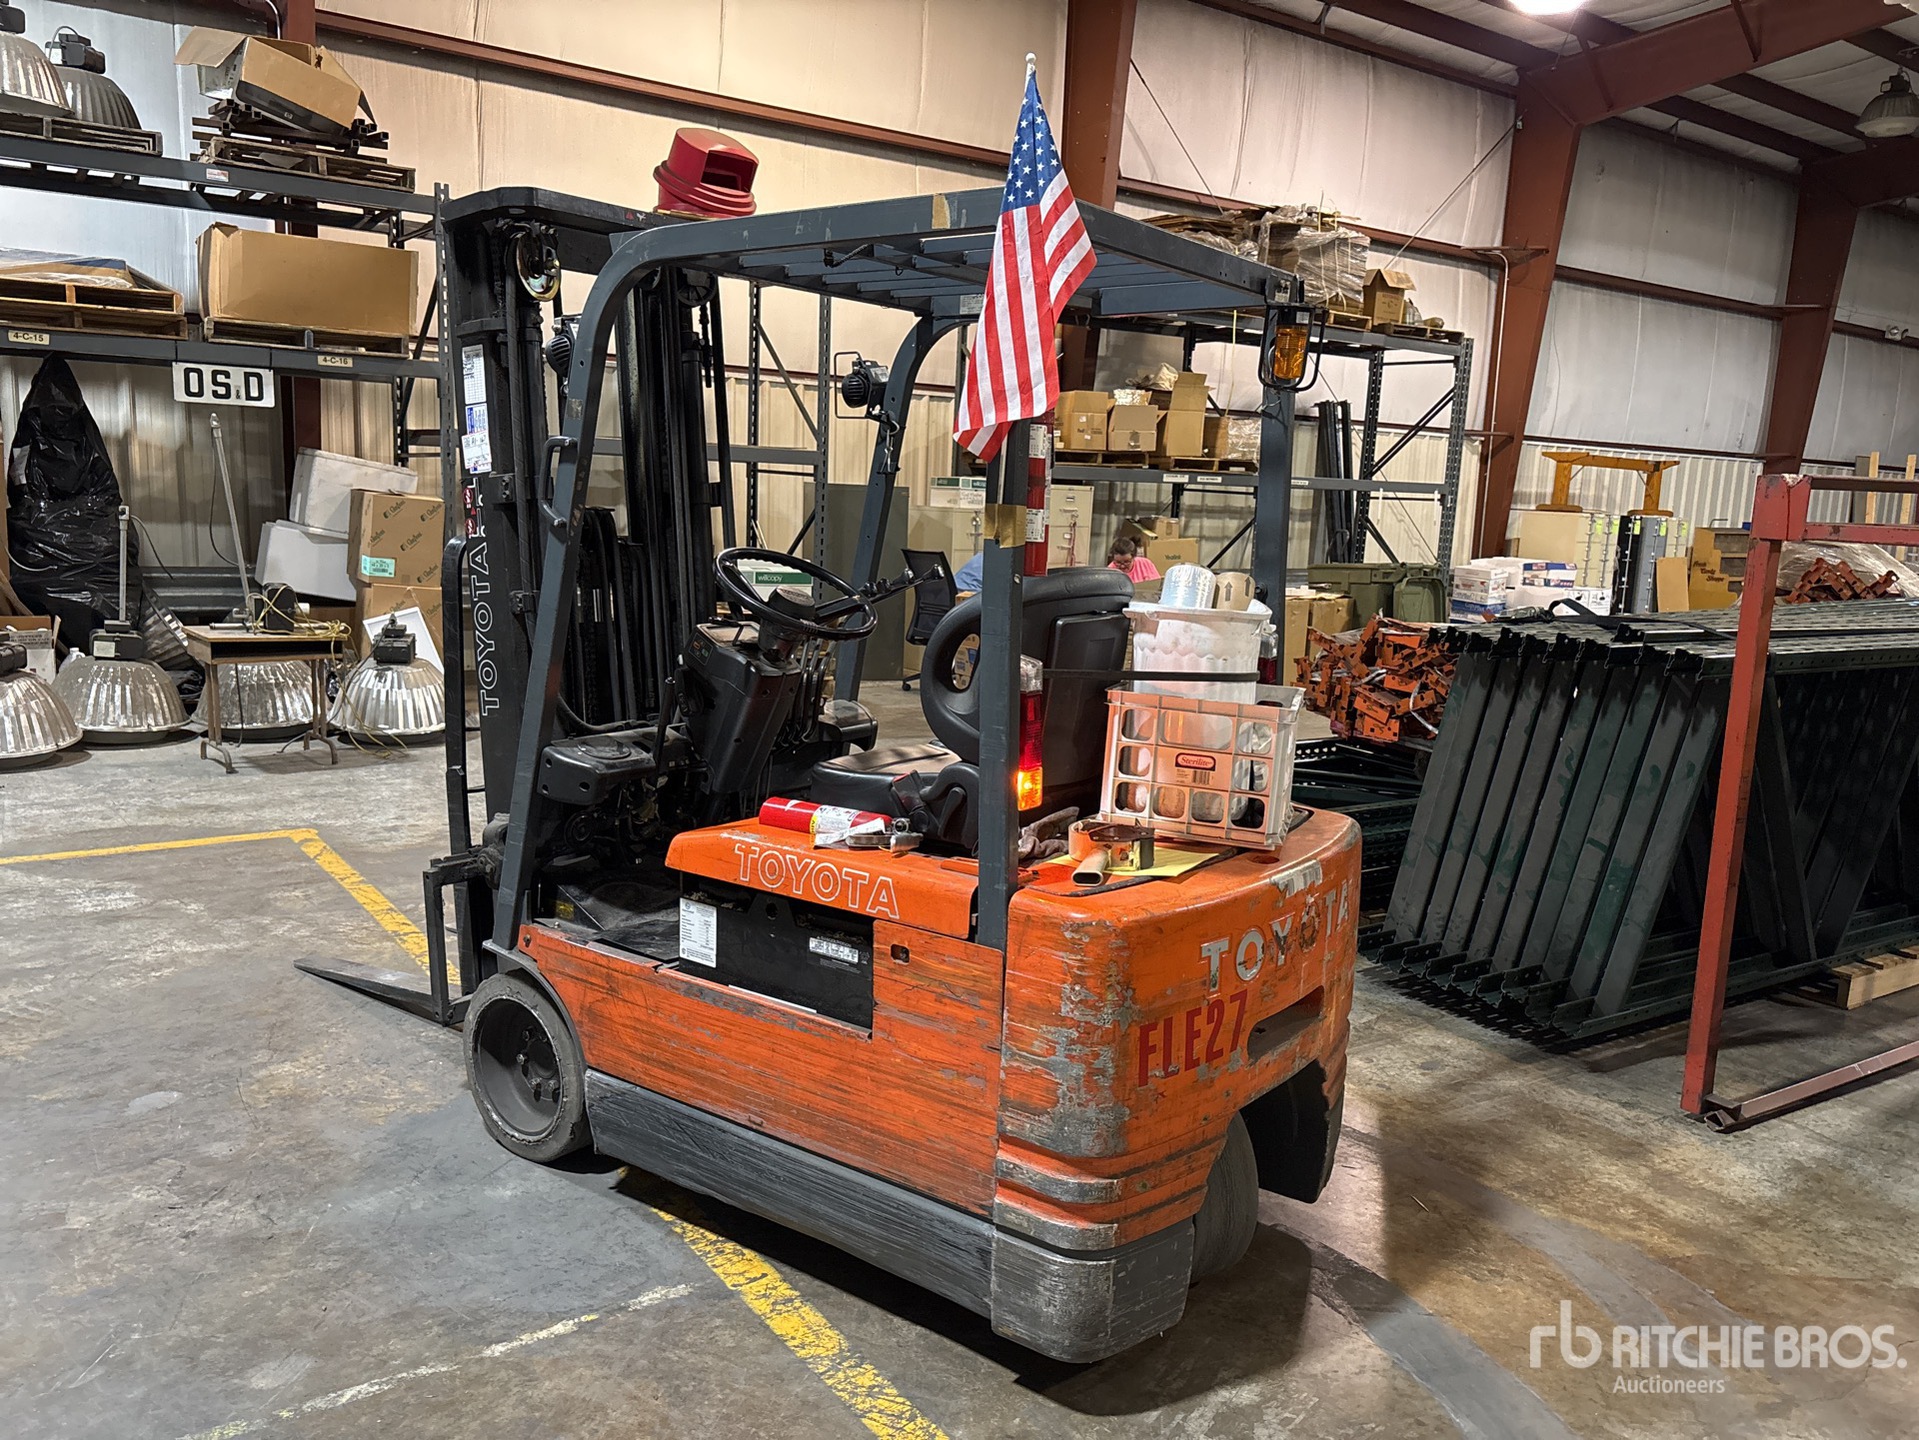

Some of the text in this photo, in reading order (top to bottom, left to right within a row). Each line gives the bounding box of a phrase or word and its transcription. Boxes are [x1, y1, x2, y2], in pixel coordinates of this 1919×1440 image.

[13, 332, 44, 342] 4-C-15
[322, 356, 349, 365] 4-C-16
[757, 573, 784, 583] willcopy
[469, 541, 500, 716] TOYOTA
[1180, 755, 1210, 767] Sterilite
[734, 843, 900, 920] TOYOTA
[1201, 879, 1352, 993] TOYOTA
[1138, 989, 1248, 1088] FLE27
